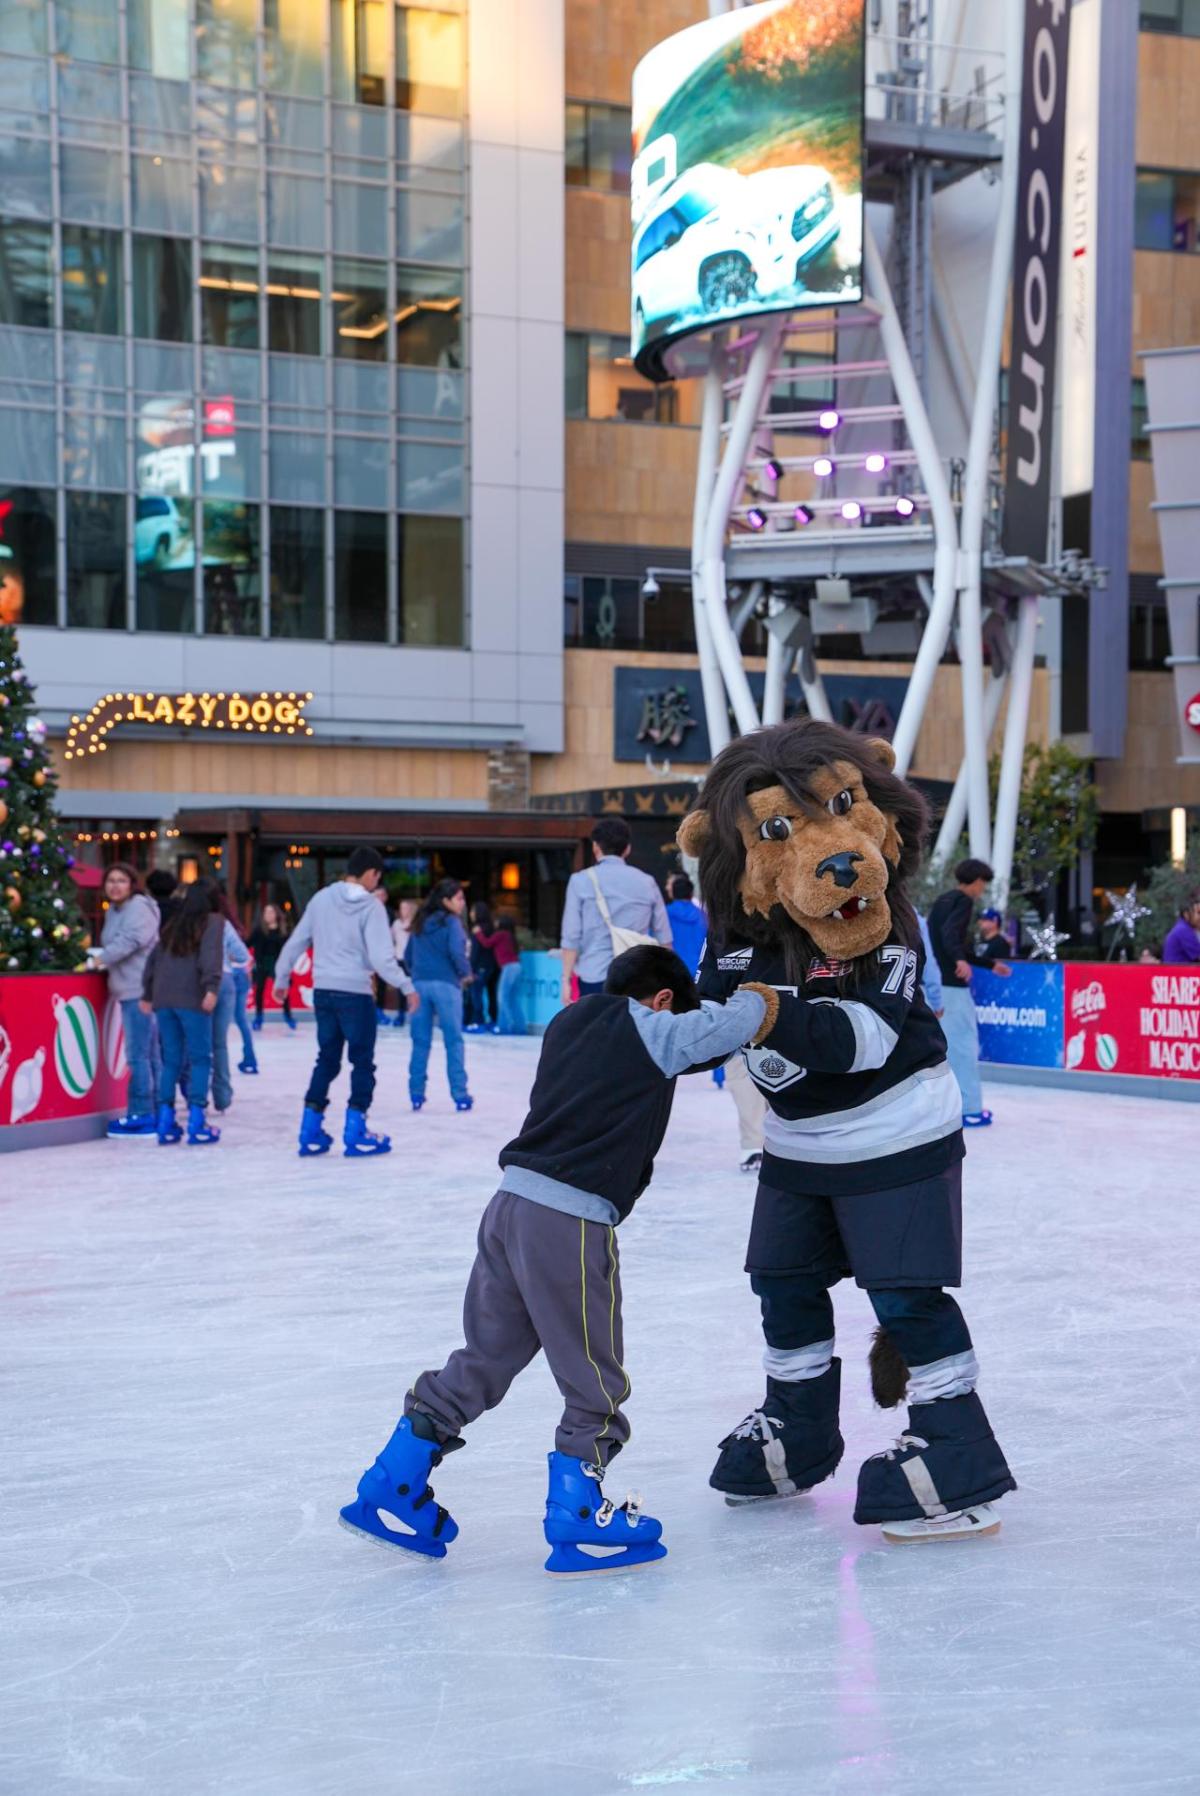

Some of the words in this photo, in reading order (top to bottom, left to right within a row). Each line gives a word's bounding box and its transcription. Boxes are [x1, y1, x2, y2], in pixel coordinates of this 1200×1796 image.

[133, 695, 217, 720] LAZY
[228, 699, 296, 724] DOG
[717, 957, 752, 966] MERCURY
[1151, 975, 1200, 1006] SHARE
[1140, 1007, 1200, 1039] HOLIDAY
[1149, 1040, 1200, 1072] MAGIC
